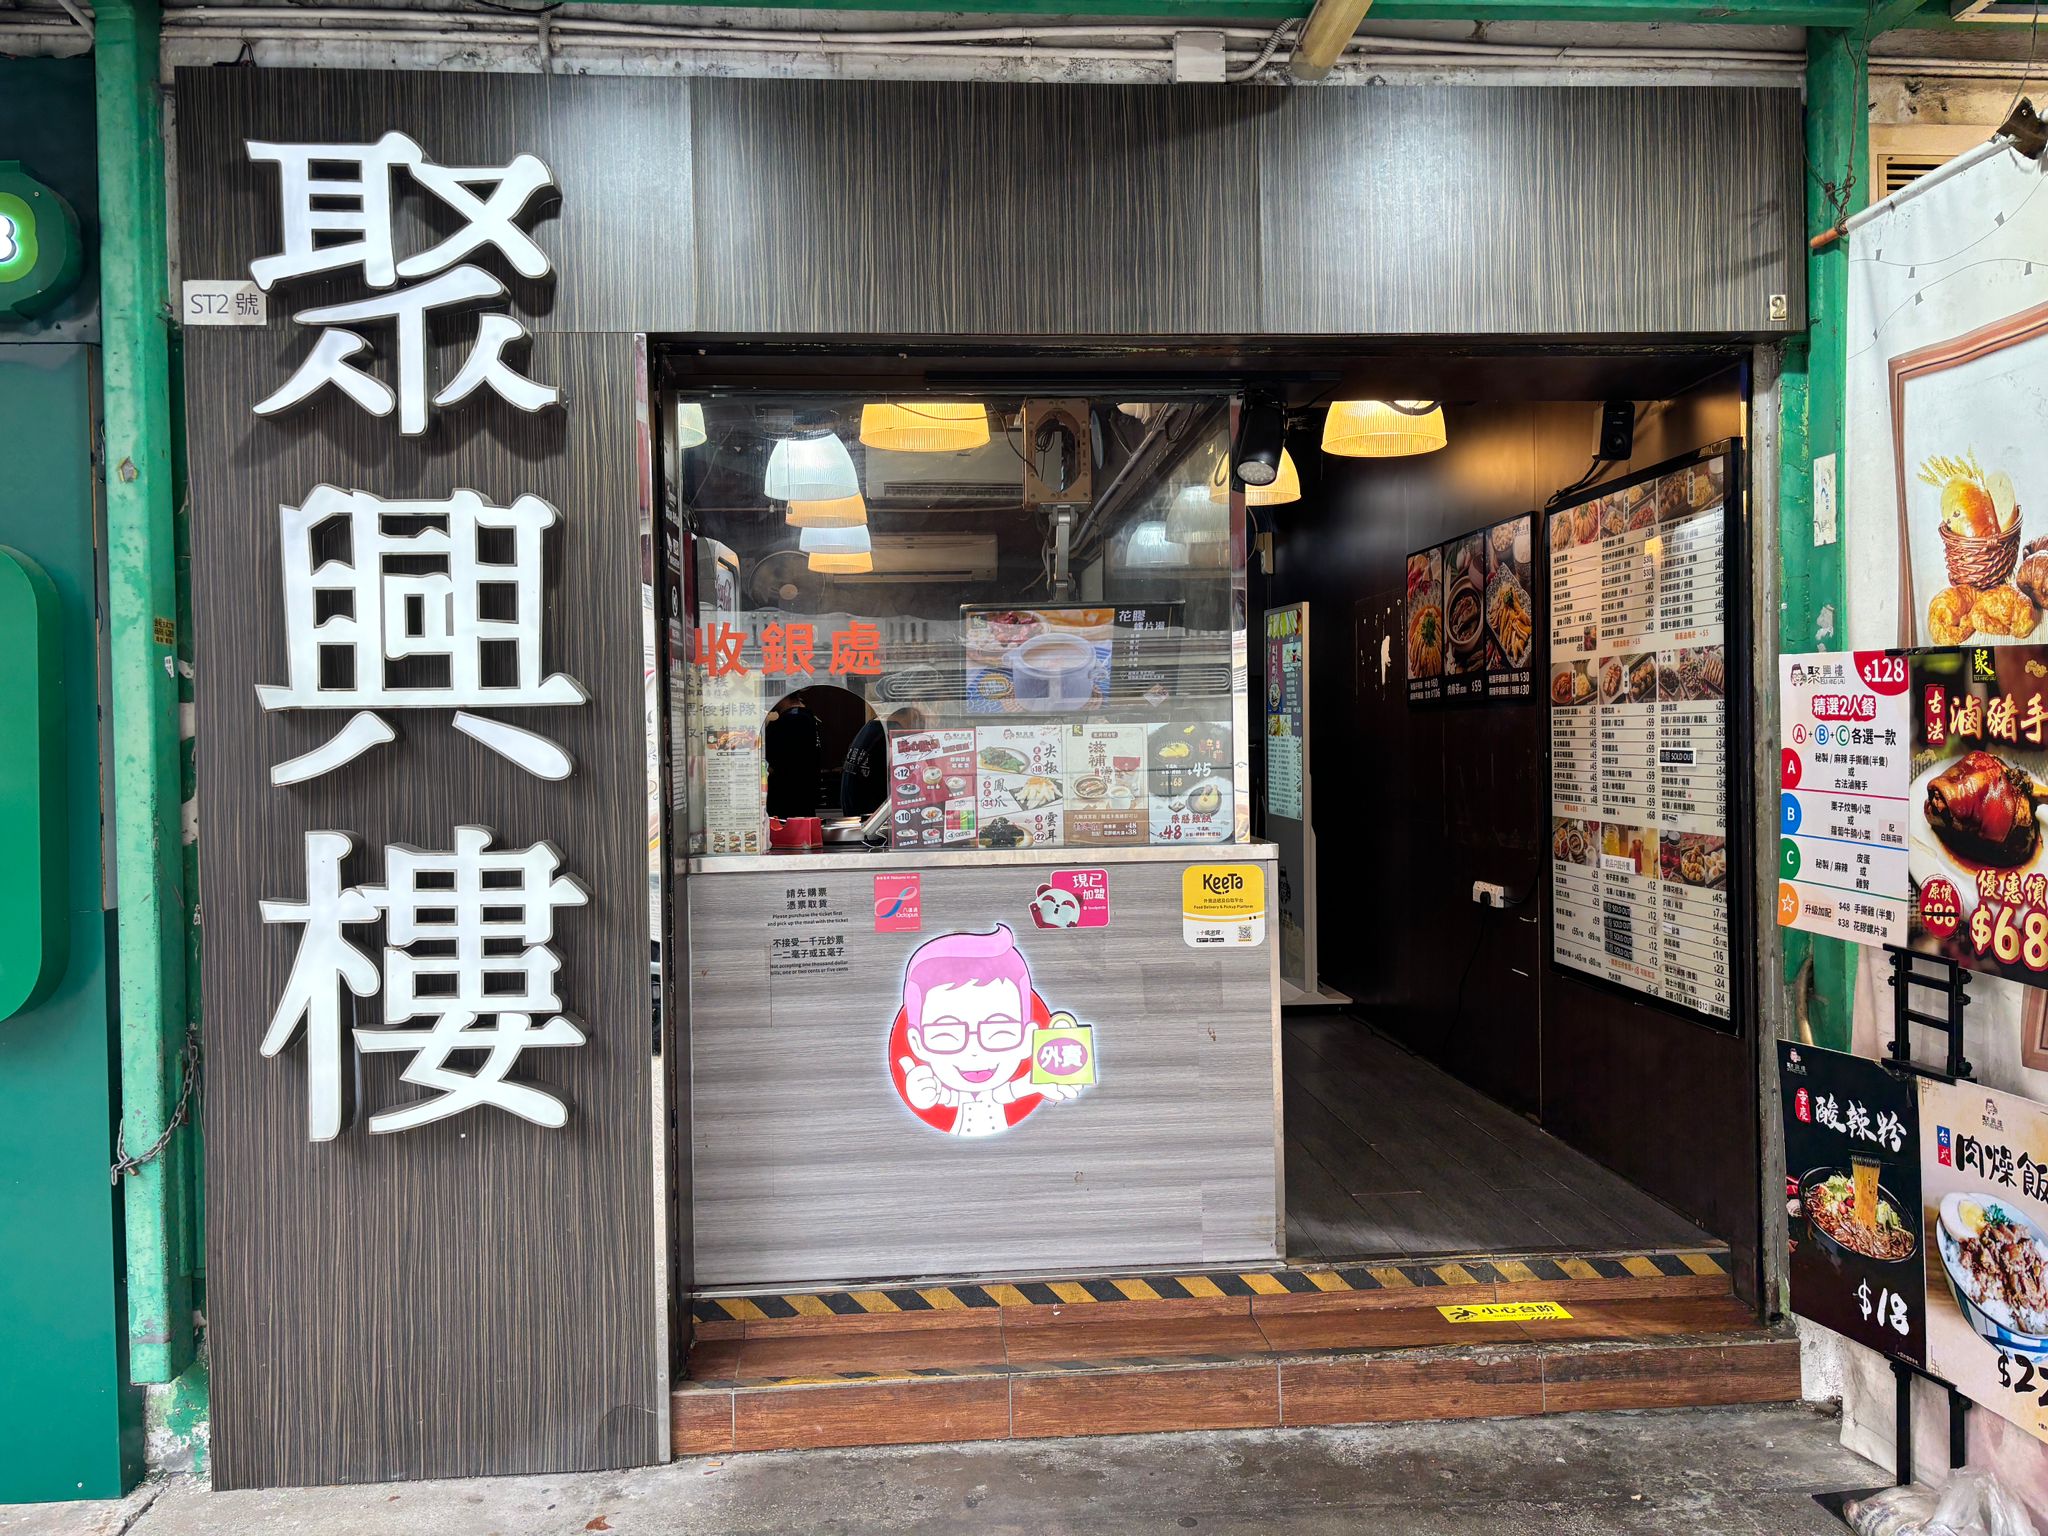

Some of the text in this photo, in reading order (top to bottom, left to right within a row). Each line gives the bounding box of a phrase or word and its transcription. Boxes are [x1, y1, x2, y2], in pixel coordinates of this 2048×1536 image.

[191, 293, 258, 315] ST2 號
[1119, 610, 1145, 621] 花膠
[245, 131, 588, 1143] 聚興樓
[695, 621, 882, 677] 收銀處
[1974, 649, 1995, 675] 聚
[1807, 664, 1844, 684] 聚興樓
[1864, 658, 1905, 682] $128
[1520, 672, 1529, 681] $30
[1472, 679, 1482, 692] $59
[1520, 685, 1529, 694] $30
[1645, 704, 1654, 713] $59
[1814, 697, 1875, 716] 精選2人餐
[1927, 690, 1944, 740] 古法
[1950, 693, 2048, 743] 滷豬手
[1645, 718, 1654, 726] $59
[1646, 731, 1654, 740] $59
[1852, 728, 1896, 746] 各選一款
[1088, 741, 1107, 767] 滋補
[1646, 744, 1654, 753] $59
[1044, 744, 1058, 775] 尖椒
[1646, 758, 1654, 766] $59
[1670, 752, 1693, 760] SOLD OUT
[1815, 753, 1888, 767] 秘製 麻辣 手撕雞(半隻)
[1188, 762, 1211, 777] $45
[1788, 760, 1796, 774] A
[1848, 767, 1855, 777] 或
[1646, 771, 1655, 780] $59
[994, 779, 1009, 807] 鳳爪
[1646, 784, 1655, 793] $59
[1646, 797, 1655, 806] $59
[1646, 810, 1656, 820] $68
[1787, 807, 1795, 820] B
[1847, 816, 1854, 825] 或
[1045, 812, 1058, 843] 雲耳
[1159, 825, 1182, 840] $48
[1831, 826, 1871, 840] 蘿蔔牛腩小菜
[1888, 824, 1895, 832] 配
[1787, 851, 1794, 864] C
[1857, 853, 1870, 864] 皮蛋
[1816, 859, 1848, 872] 秘製 麻辣
[1860, 867, 1866, 877] 或
[1072, 874, 1102, 888] 現已
[1203, 873, 1243, 894] KeeTa
[1647, 880, 1656, 890] $12
[1856, 878, 1869, 890] 雞腎
[786, 888, 827, 898] 請先購票
[1083, 889, 1105, 900] 加盟
[1928, 883, 1952, 904] 原價
[1978, 870, 2046, 910] 優惠價
[1647, 895, 1656, 905] $12
[1805, 904, 1832, 918] 升級加配
[1839, 902, 1850, 912] $48
[1854, 904, 1874, 916] 手撕雞
[1648, 911, 1656, 921] $12
[1838, 919, 1850, 928] $38
[1648, 925, 1657, 935] $12
[1972, 904, 2048, 967] $68
[773, 935, 844, 947] 不接受一千元鈔票
[1648, 940, 1657, 951] $12
[773, 948, 844, 958] 一二毫子或五毫子
[1713, 949, 1723, 960] $16
[1648, 955, 1657, 966] $12
[1713, 964, 1724, 974] $22
[1714, 977, 1724, 989] $24
[1715, 992, 1724, 1003] $24
[1699, 1000, 1707, 1011] $12
[1797, 1090, 1808, 1120] 重慶
[1815, 1092, 1907, 1152] 酸辣粉
[1939, 1129, 1950, 1163] 台式
[1956, 1134, 2048, 1204] 肉燥飯
[1854, 1277, 1910, 1336] $18
